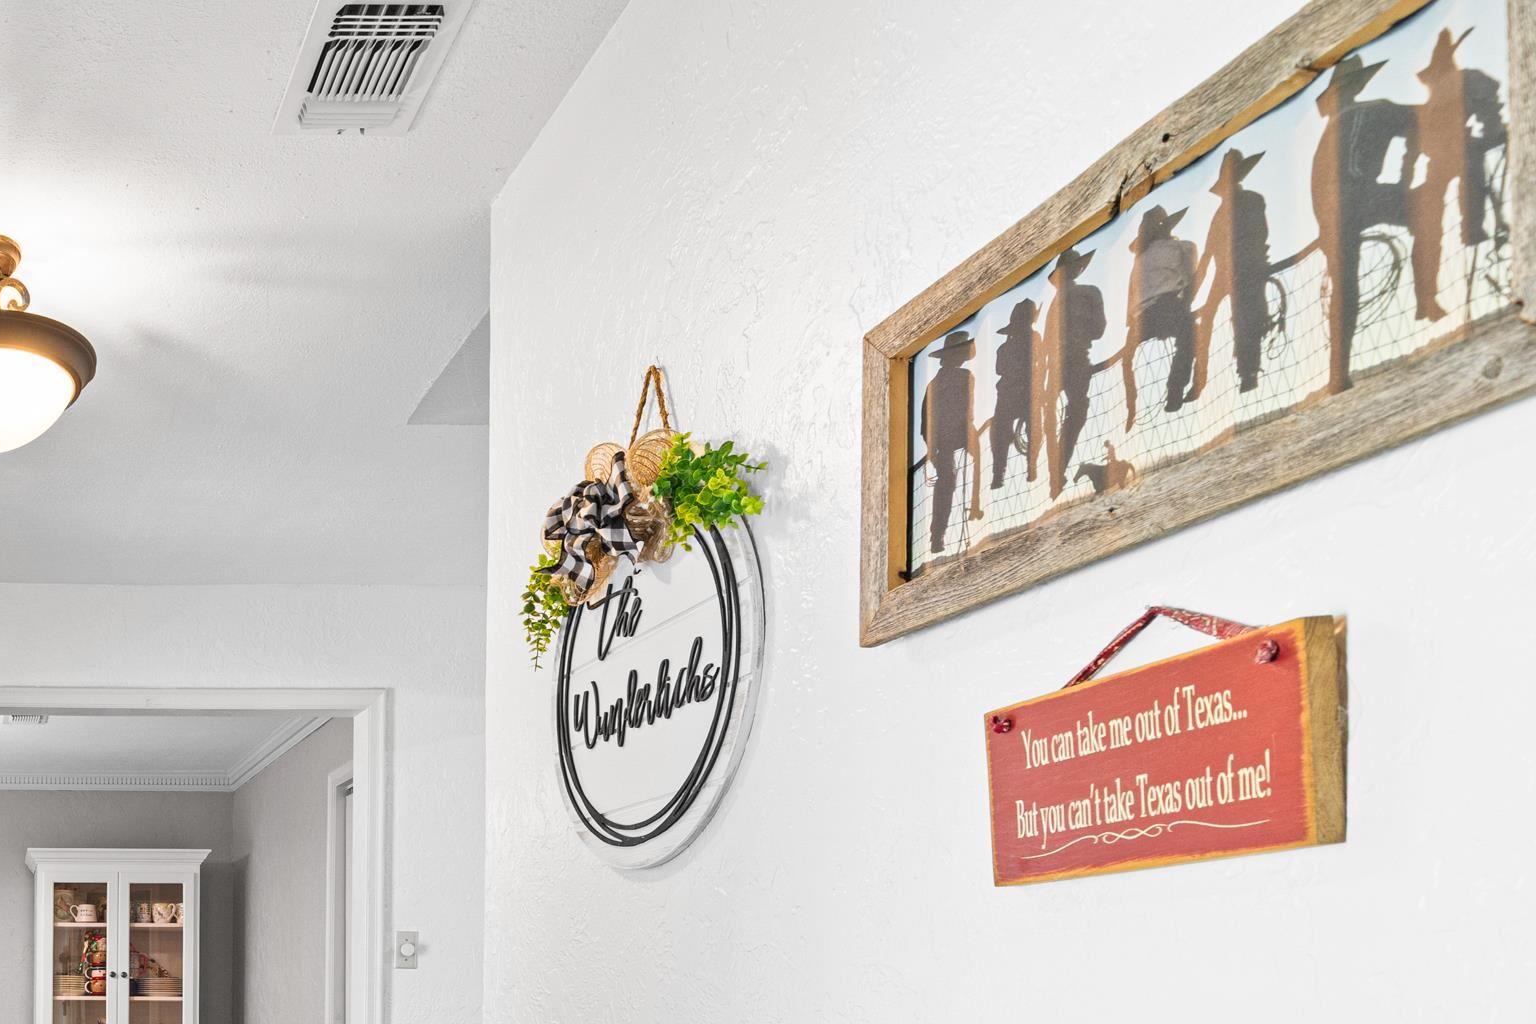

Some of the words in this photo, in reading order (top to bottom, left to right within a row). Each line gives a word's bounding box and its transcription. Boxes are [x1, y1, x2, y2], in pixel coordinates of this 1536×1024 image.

[1021, 730, 1049, 769] You
[1051, 731, 1075, 762] can
[1077, 711, 1106, 758] take
[1110, 714, 1132, 750] me
[1135, 700, 1161, 743] out
[1164, 687, 1183, 735] of
[1182, 684, 1248, 732] Texas...
[1015, 799, 1039, 839] But
[1040, 804, 1065, 849] you
[1068, 783, 1102, 829] can't
[1103, 778, 1134, 823] take
[1135, 774, 1182, 817] Texas
[1185, 766, 1213, 808] out
[1216, 754, 1237, 801] of
[1239, 749, 1272, 799] me!
